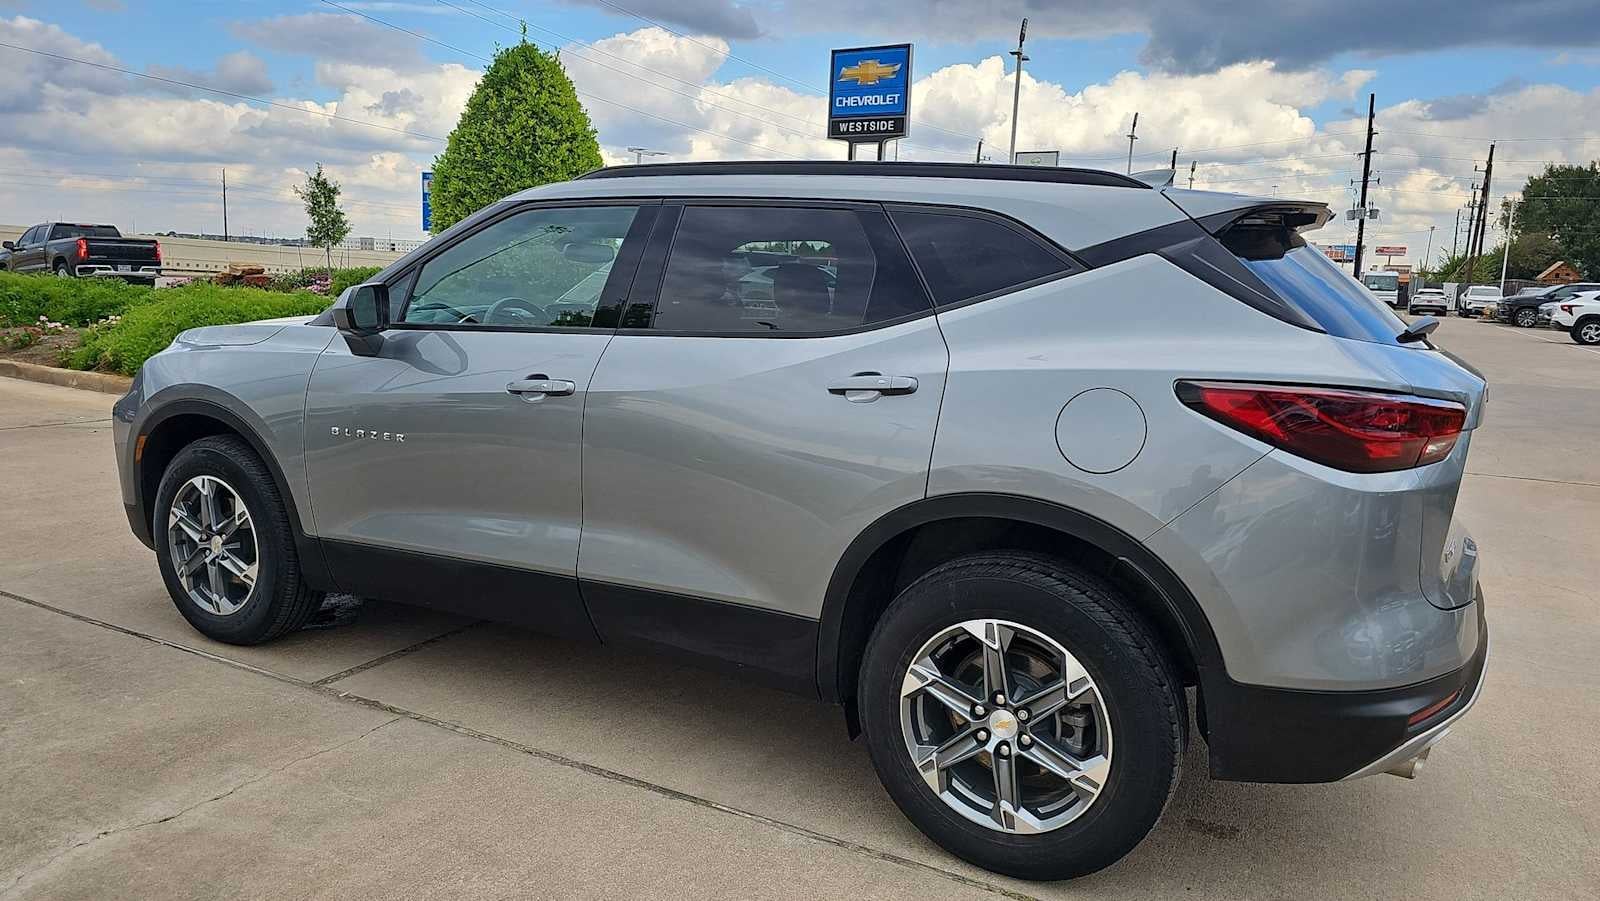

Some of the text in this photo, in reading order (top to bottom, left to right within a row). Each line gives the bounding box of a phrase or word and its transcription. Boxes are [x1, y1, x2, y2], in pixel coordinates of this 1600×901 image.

[835, 94, 900, 107] CHEVROLET
[839, 120, 895, 132] WESTSIDE
[331, 426, 405, 442] BLAZER
